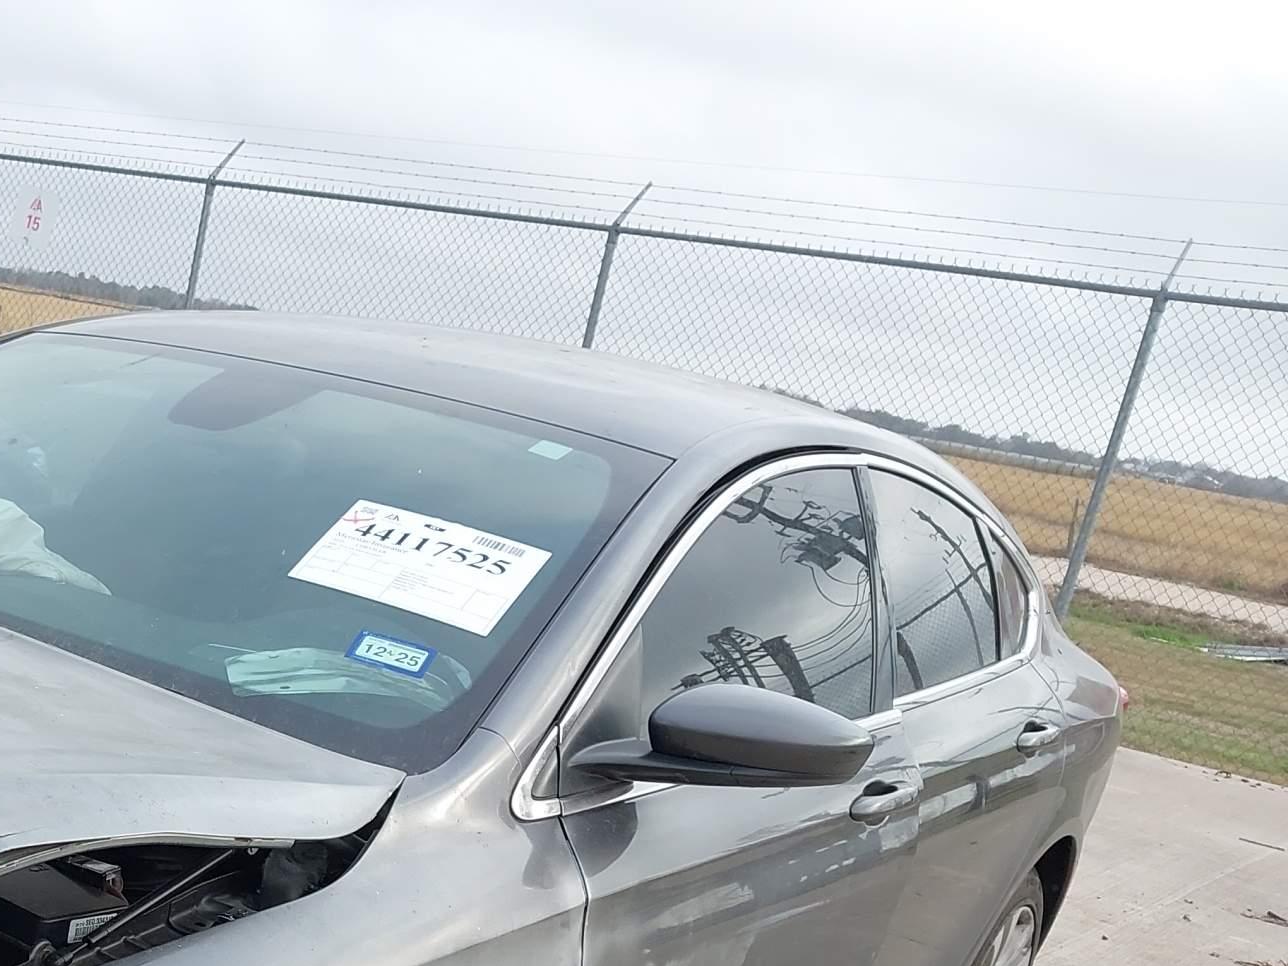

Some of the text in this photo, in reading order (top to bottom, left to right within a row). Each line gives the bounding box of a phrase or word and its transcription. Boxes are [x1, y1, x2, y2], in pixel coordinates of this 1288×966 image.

[26, 214, 41, 231] 15
[354, 523, 513, 576] 44117525
[364, 643, 422, 667] 12 25
